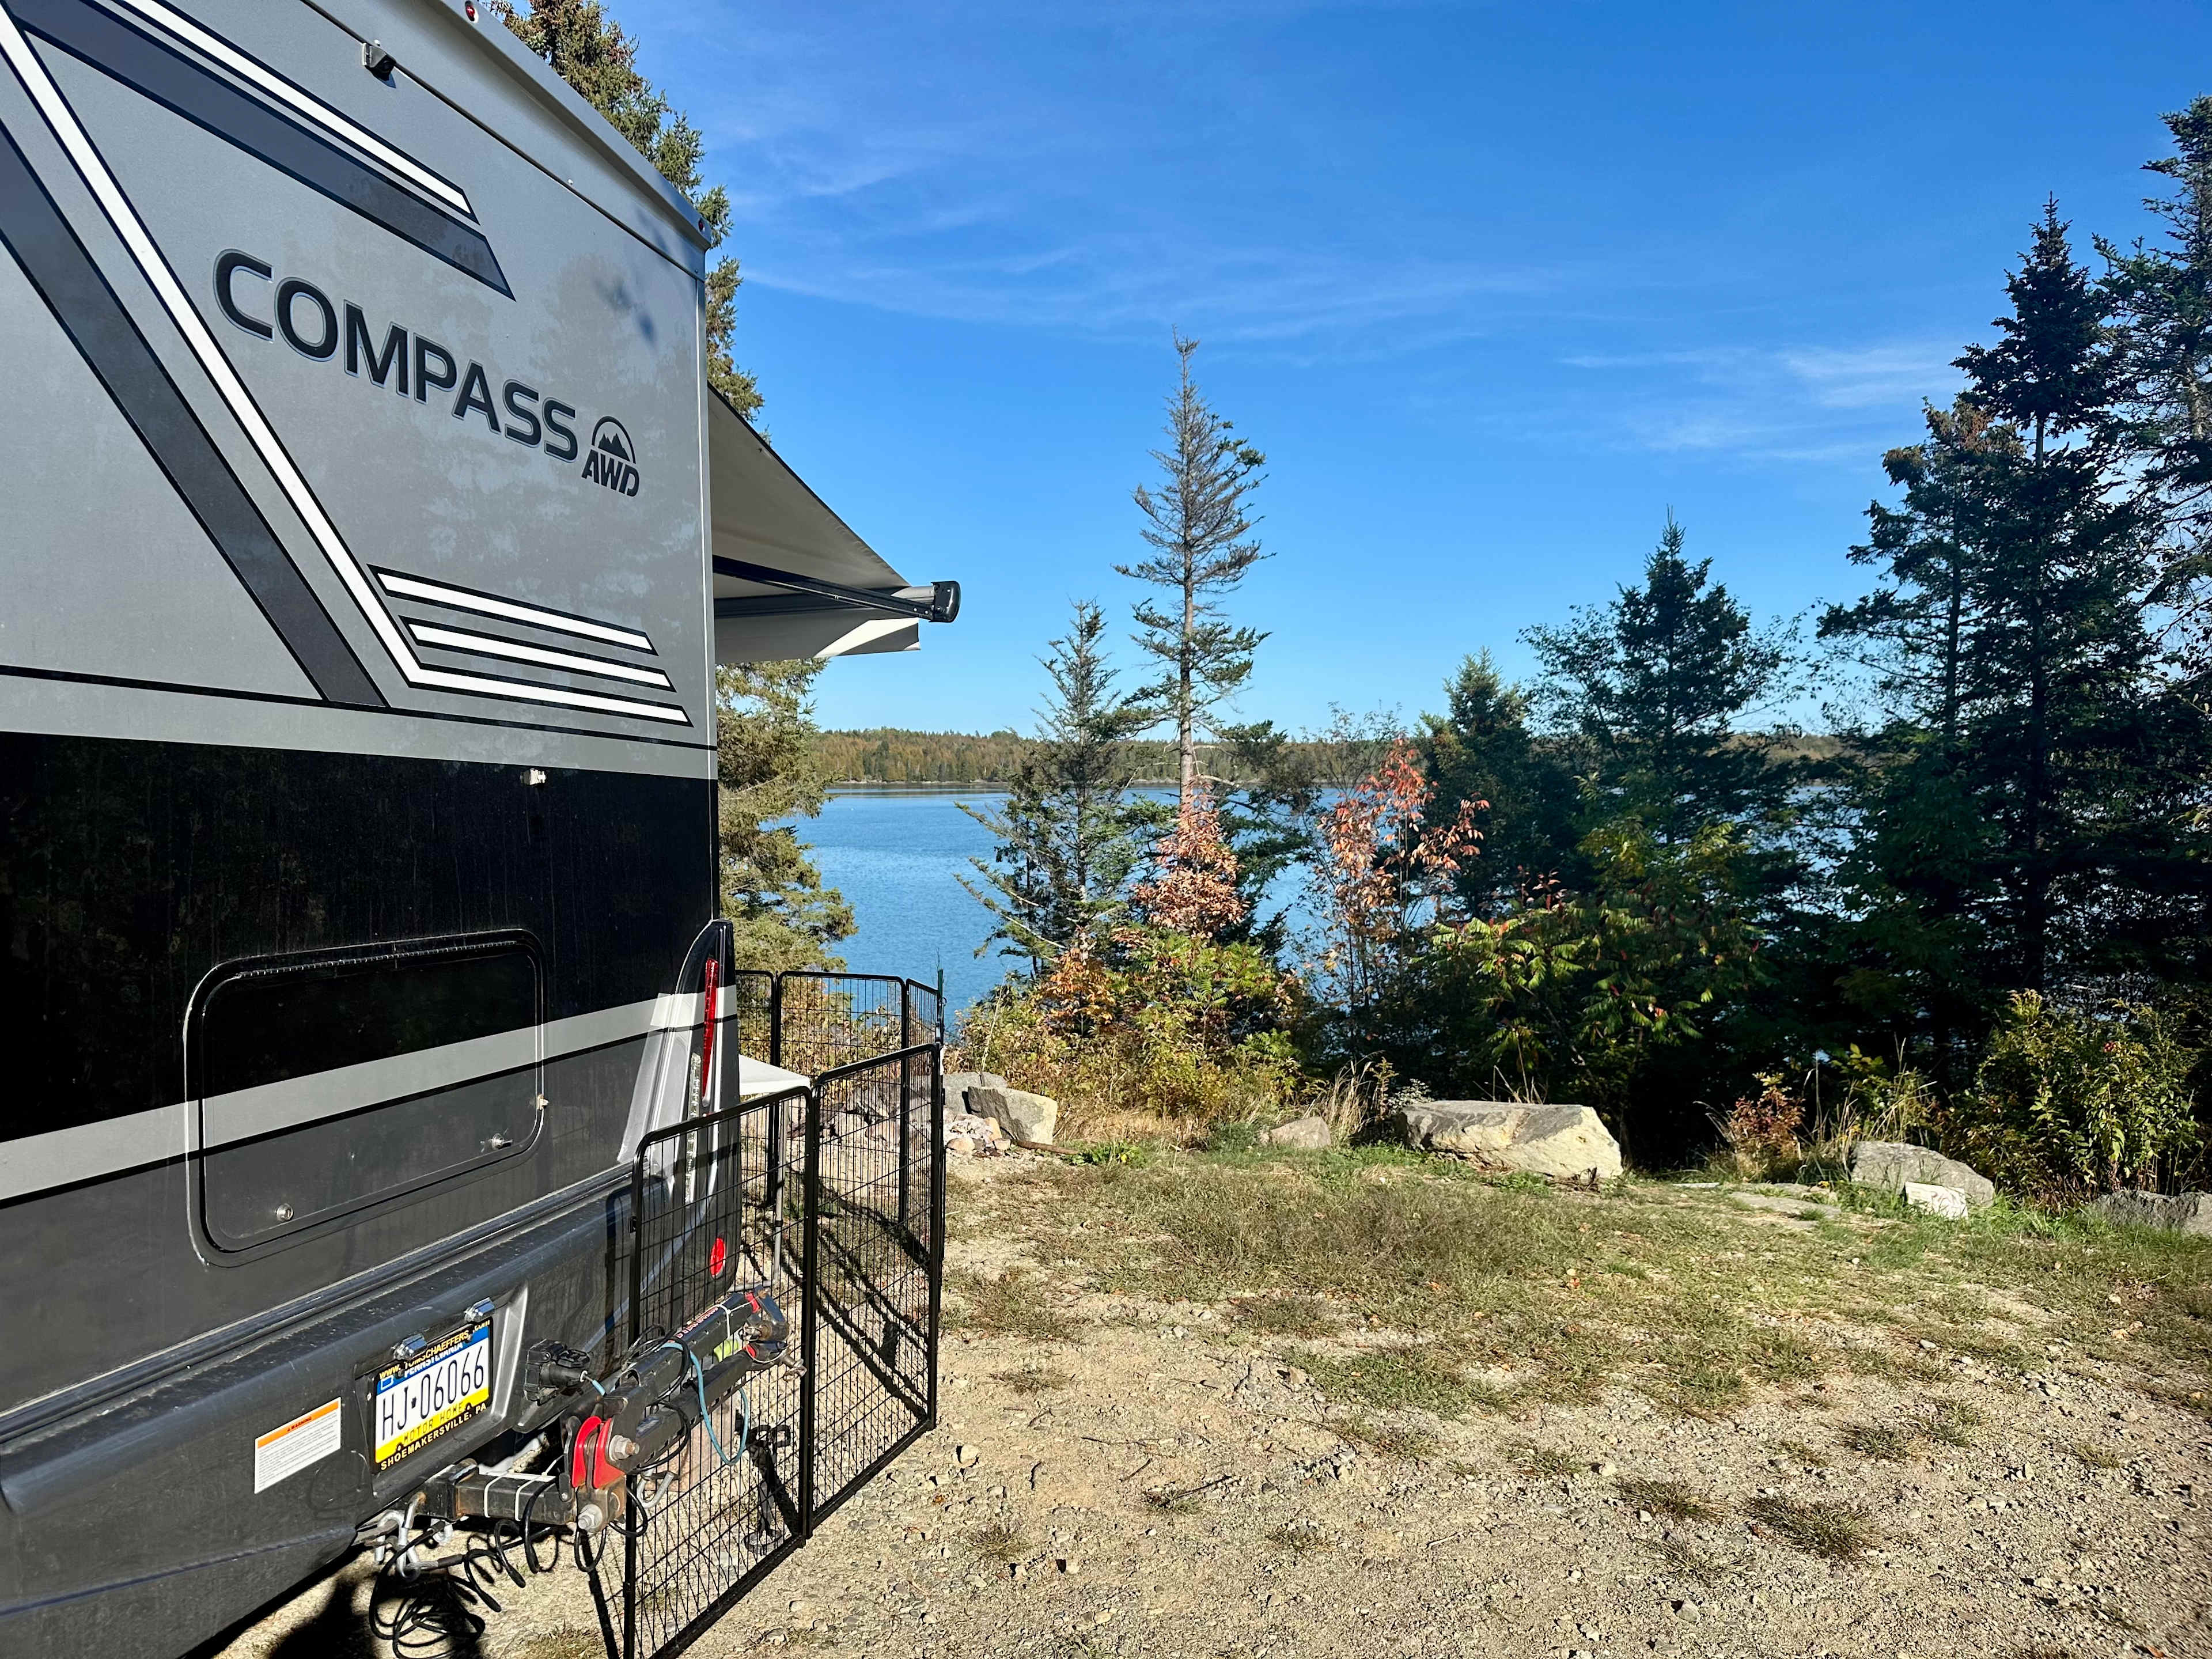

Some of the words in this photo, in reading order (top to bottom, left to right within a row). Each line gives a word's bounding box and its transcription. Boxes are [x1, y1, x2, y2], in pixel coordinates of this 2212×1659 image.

[214, 248, 578, 463] COMPASS
[581, 449, 639, 497] AWD
[404, 1342, 463, 1378] PENNSYLVANIA
[403, 1418, 433, 1442] MOTOR
[440, 1401, 464, 1424] HOME
[475, 1402, 487, 1414] PA
